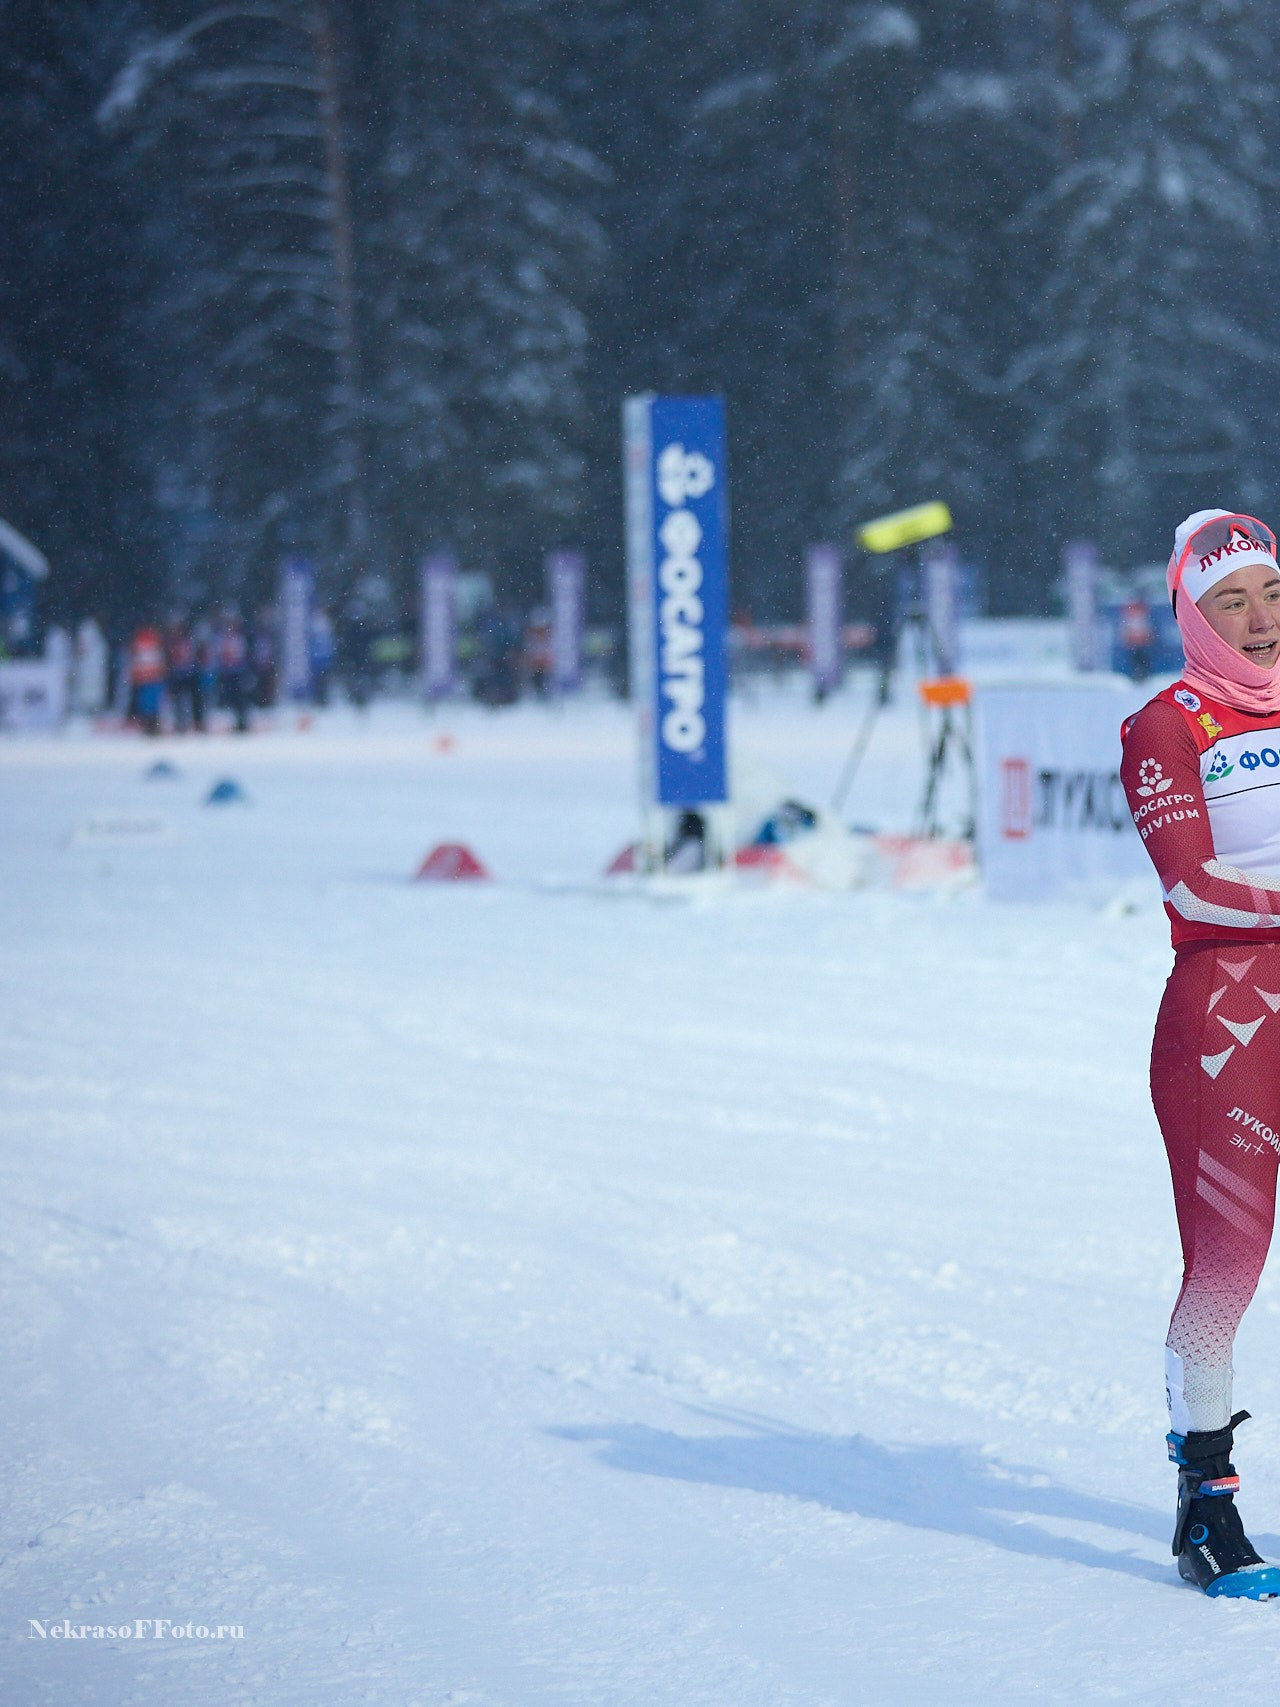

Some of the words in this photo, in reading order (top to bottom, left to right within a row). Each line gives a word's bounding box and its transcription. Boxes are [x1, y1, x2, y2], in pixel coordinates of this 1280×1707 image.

[1133, 793, 1195, 823] ФОСАГРО
[1140, 808, 1200, 840] BIVIUM
[1199, 1544, 1221, 1574] SALOMON
